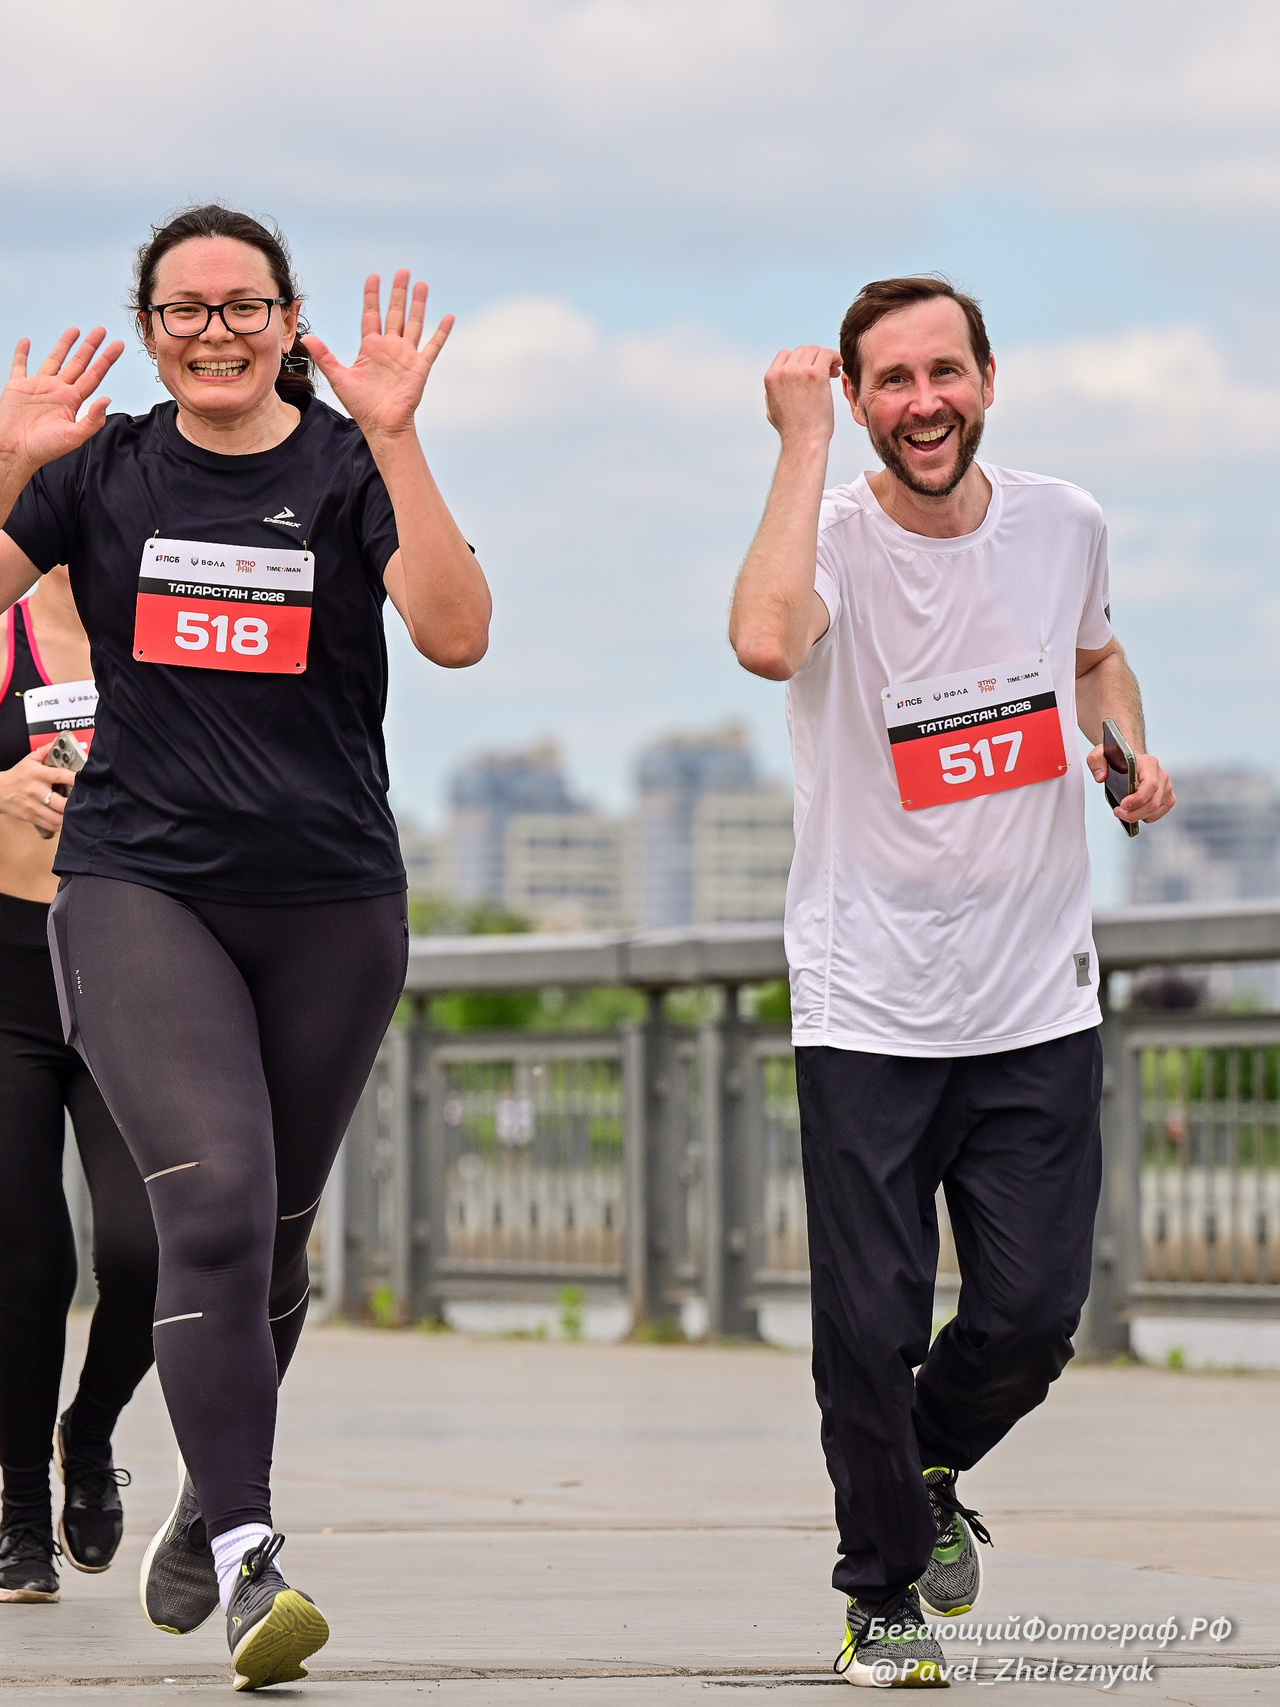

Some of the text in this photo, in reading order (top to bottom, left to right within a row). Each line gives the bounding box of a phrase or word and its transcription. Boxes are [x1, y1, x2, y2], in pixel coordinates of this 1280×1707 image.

[163, 555, 180, 563] ПСБ
[201, 559, 225, 568] ВФЛА
[235, 559, 256, 567] ЭТНО
[168, 582, 285, 602] ТАТАРСТАН 2026
[174, 610, 269, 656] 518
[977, 678, 997, 688] ЭТНО
[943, 688, 968, 698] ВФЛА
[905, 697, 922, 707] ПСБ
[918, 700, 1031, 734] ТАТАРСТАН 2026
[938, 730, 1023, 784] 517
